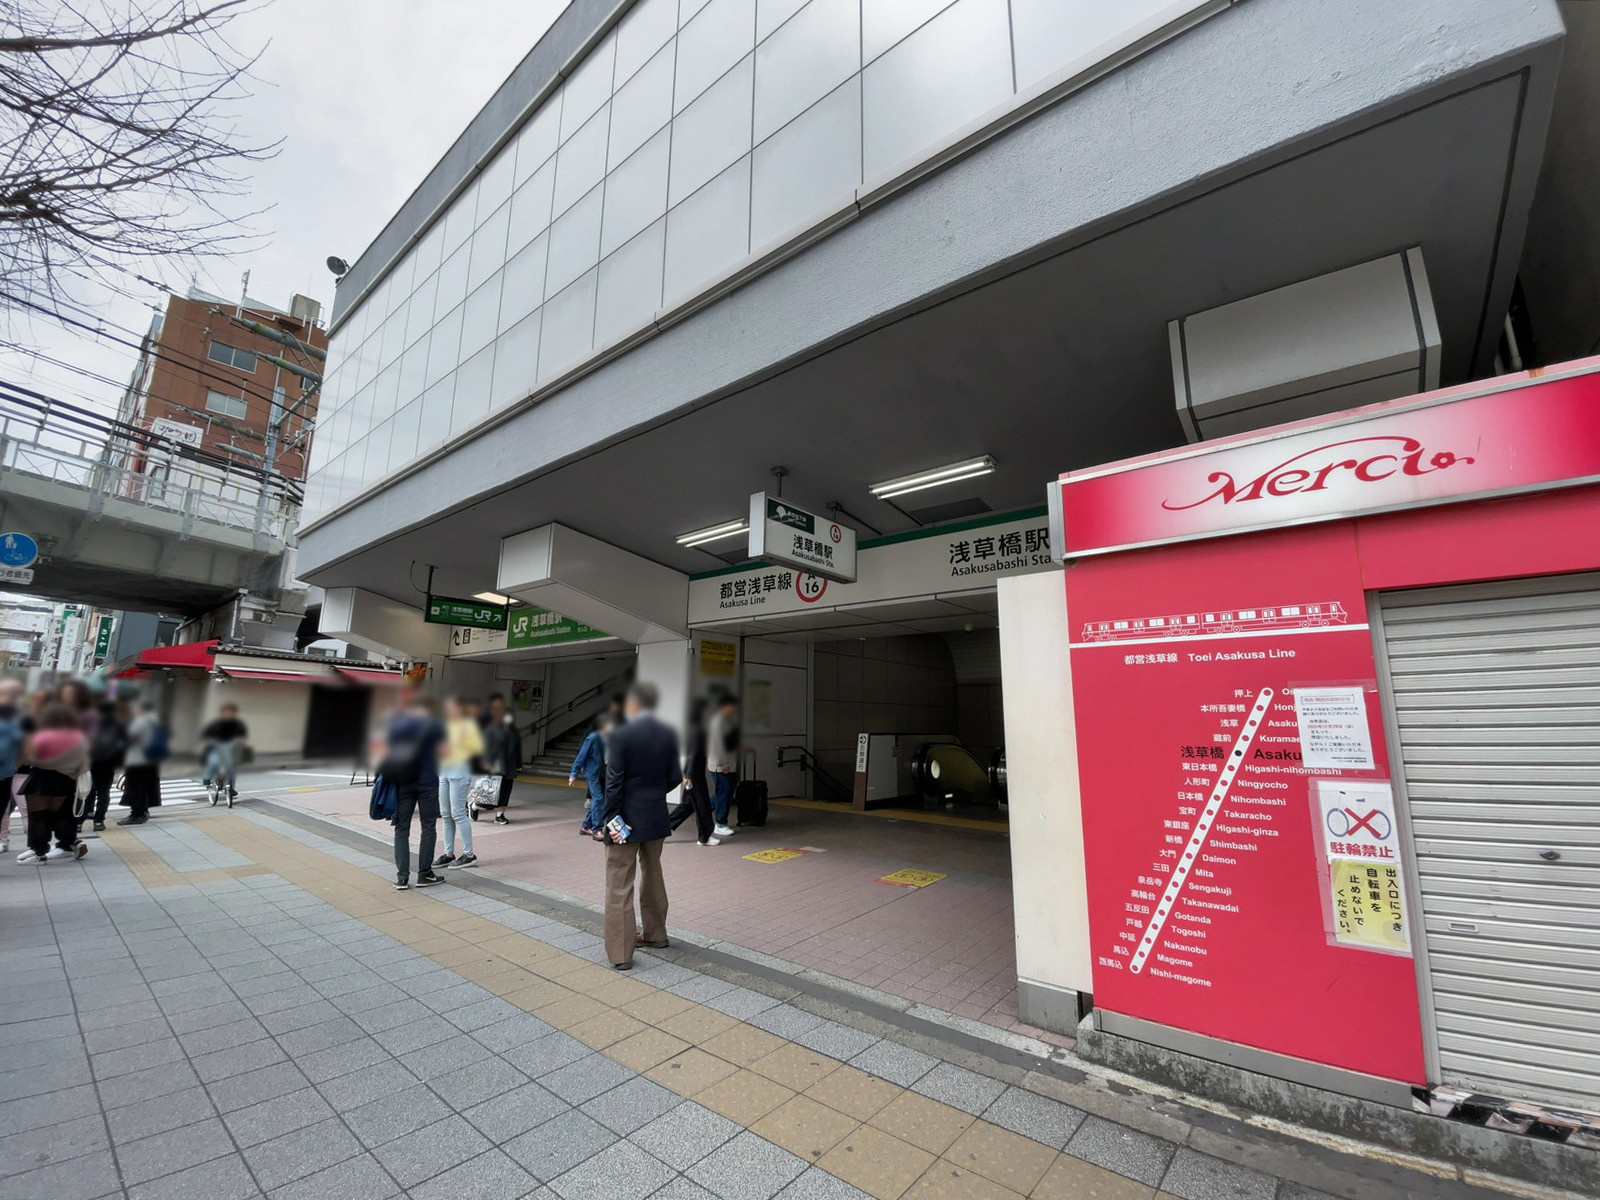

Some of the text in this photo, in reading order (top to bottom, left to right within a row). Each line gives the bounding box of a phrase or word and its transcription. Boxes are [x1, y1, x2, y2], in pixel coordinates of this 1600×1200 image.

[794, 534, 832, 559] 浅草橋駅
[950, 527, 1049, 564] 浅草橋駅
[951, 555, 1028, 576] Asakusabashi
[720, 572, 792, 599] 都営浅草線
[805, 582, 819, 594] 16
[720, 596, 765, 609] Asakusa Line
[474, 610, 491, 620] JR
[513, 617, 528, 633] JR
[1124, 648, 1296, 665] 都営浅草線 Toei Asakusa Line
[1234, 689, 1253, 698] 押上
[1220, 719, 1239, 727] 浅草
[1213, 734, 1231, 742] 蔵前
[1181, 745, 1224, 759] 浅草橋
[1182, 763, 1217, 772] 東日本橋
[1245, 764, 1342, 776] Higashi-nihombashi
[1184, 777, 1210, 786] 人形町
[1238, 780, 1288, 789] Ningyocho
[1178, 792, 1203, 801] 日本橋
[1231, 795, 1286, 806] Nihombashi
[1179, 807, 1196, 815] 宝町
[1224, 810, 1272, 820] Takaracho
[1164, 820, 1189, 830] 東銀座
[1216, 824, 1279, 836] Higashi-ginza
[1166, 835, 1183, 844] 新橋
[1210, 840, 1257, 851] Shimbashi
[1330, 842, 1394, 858] 駐輪禁止
[1160, 850, 1176, 858] 大門
[1202, 855, 1236, 864] Daimon
[1153, 863, 1169, 872] 三田
[1195, 869, 1214, 878] Mita
[1138, 876, 1162, 887] 泉岳寺
[1131, 890, 1156, 900] 高輪台
[1189, 883, 1232, 896] Sengakuji
[1367, 868, 1381, 912] 自転車を
[1182, 898, 1239, 912] Takanawadai
[1350, 875, 1364, 925] 止めないで
[1386, 869, 1402, 932] 出入口につき
[1125, 903, 1149, 914] 五反田
[1337, 889, 1350, 933] ください。
[1126, 918, 1142, 928] 戸越
[1175, 912, 1211, 924] Gotanda
[1120, 932, 1136, 941] 中延
[1171, 926, 1206, 938] Togoshi
[1113, 946, 1129, 956] 馬込
[1164, 941, 1207, 955] Nakanobu
[1099, 957, 1123, 969] 西馬込
[1157, 954, 1193, 967] Magome
[1150, 968, 1211, 986] Nishi-magome
